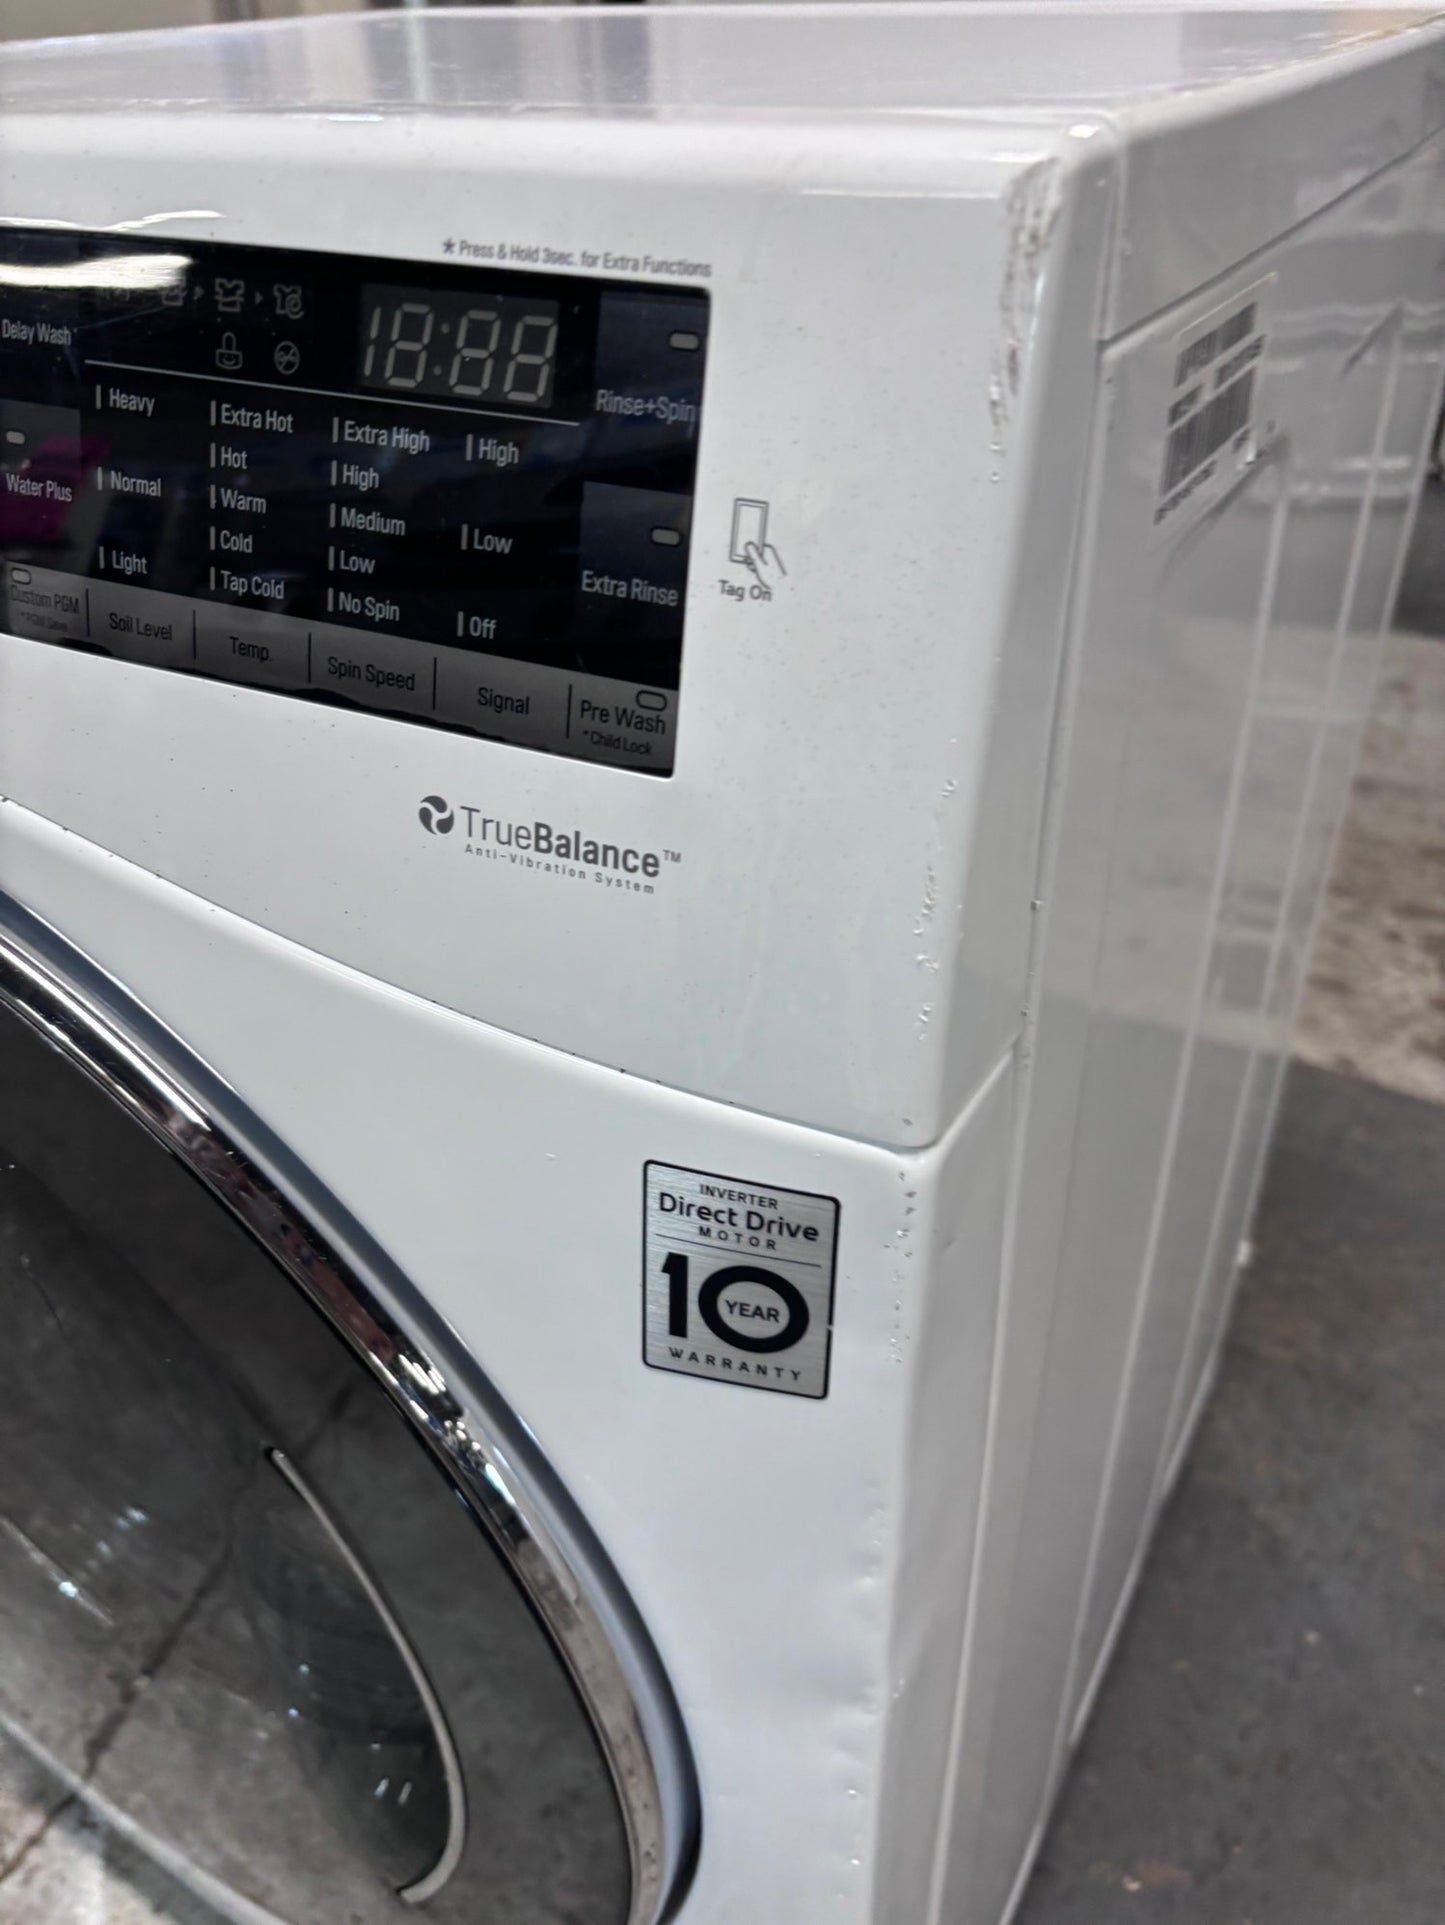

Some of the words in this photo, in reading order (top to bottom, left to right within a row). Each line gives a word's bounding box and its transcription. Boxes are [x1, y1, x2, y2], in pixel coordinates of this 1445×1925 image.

[459, 240, 495, 259] Press
[510, 245, 539, 263] Hold
[580, 251, 600, 268] for
[602, 252, 640, 273] Extra
[642, 255, 711, 278] Functions
[2, 318, 34, 341] Delay
[37, 322, 72, 346] Wash
[109, 388, 155, 416] Heavy
[595, 388, 696, 424] Rinse+Spin
[221, 403, 262, 429] Extra
[266, 409, 294, 434] Hot
[344, 420, 388, 446] Extra
[391, 426, 430, 455] High
[478, 437, 519, 467] High
[220, 447, 248, 470] Hot
[6, 473, 45, 498] Water
[46, 480, 73, 502] Plus
[110, 470, 162, 497] Normal
[342, 463, 379, 491] High
[220, 487, 267, 514] Warm
[340, 506, 406, 537] Medium
[219, 529, 253, 554] Cold
[473, 528, 513, 555] Low
[111, 550, 148, 576] Light
[339, 549, 376, 575] Low
[220, 569, 249, 595] Tap
[250, 574, 285, 600] Cold
[580, 570, 628, 600] Extra
[630, 577, 680, 608] Rinse
[717, 579, 745, 602] Tag
[749, 583, 773, 603] On
[54, 593, 80, 615] PGM
[338, 591, 362, 615] No
[364, 596, 400, 623] Spin
[108, 612, 135, 635] Soil
[136, 617, 173, 642] Level
[469, 615, 498, 640] Off
[228, 635, 274, 664] Temp.
[327, 656, 362, 681] Spin
[364, 663, 416, 692] Speed
[477, 686, 531, 716] Signal
[579, 699, 611, 725] Pre
[614, 706, 667, 737] Wash
[622, 738, 653, 756] Lock
[464, 843, 588, 880] Anti-Vibration
[594, 872, 656, 896] System
[700, 1184, 779, 1211] INVERTER
[658, 1191, 740, 1228] Direct
[745, 1210, 821, 1243] Drive
[698, 1226, 778, 1251] MOTOR
[660, 1251, 811, 1355] 10
[724, 1299, 782, 1325] YEAR
[668, 1346, 803, 1382] WARRANTY
